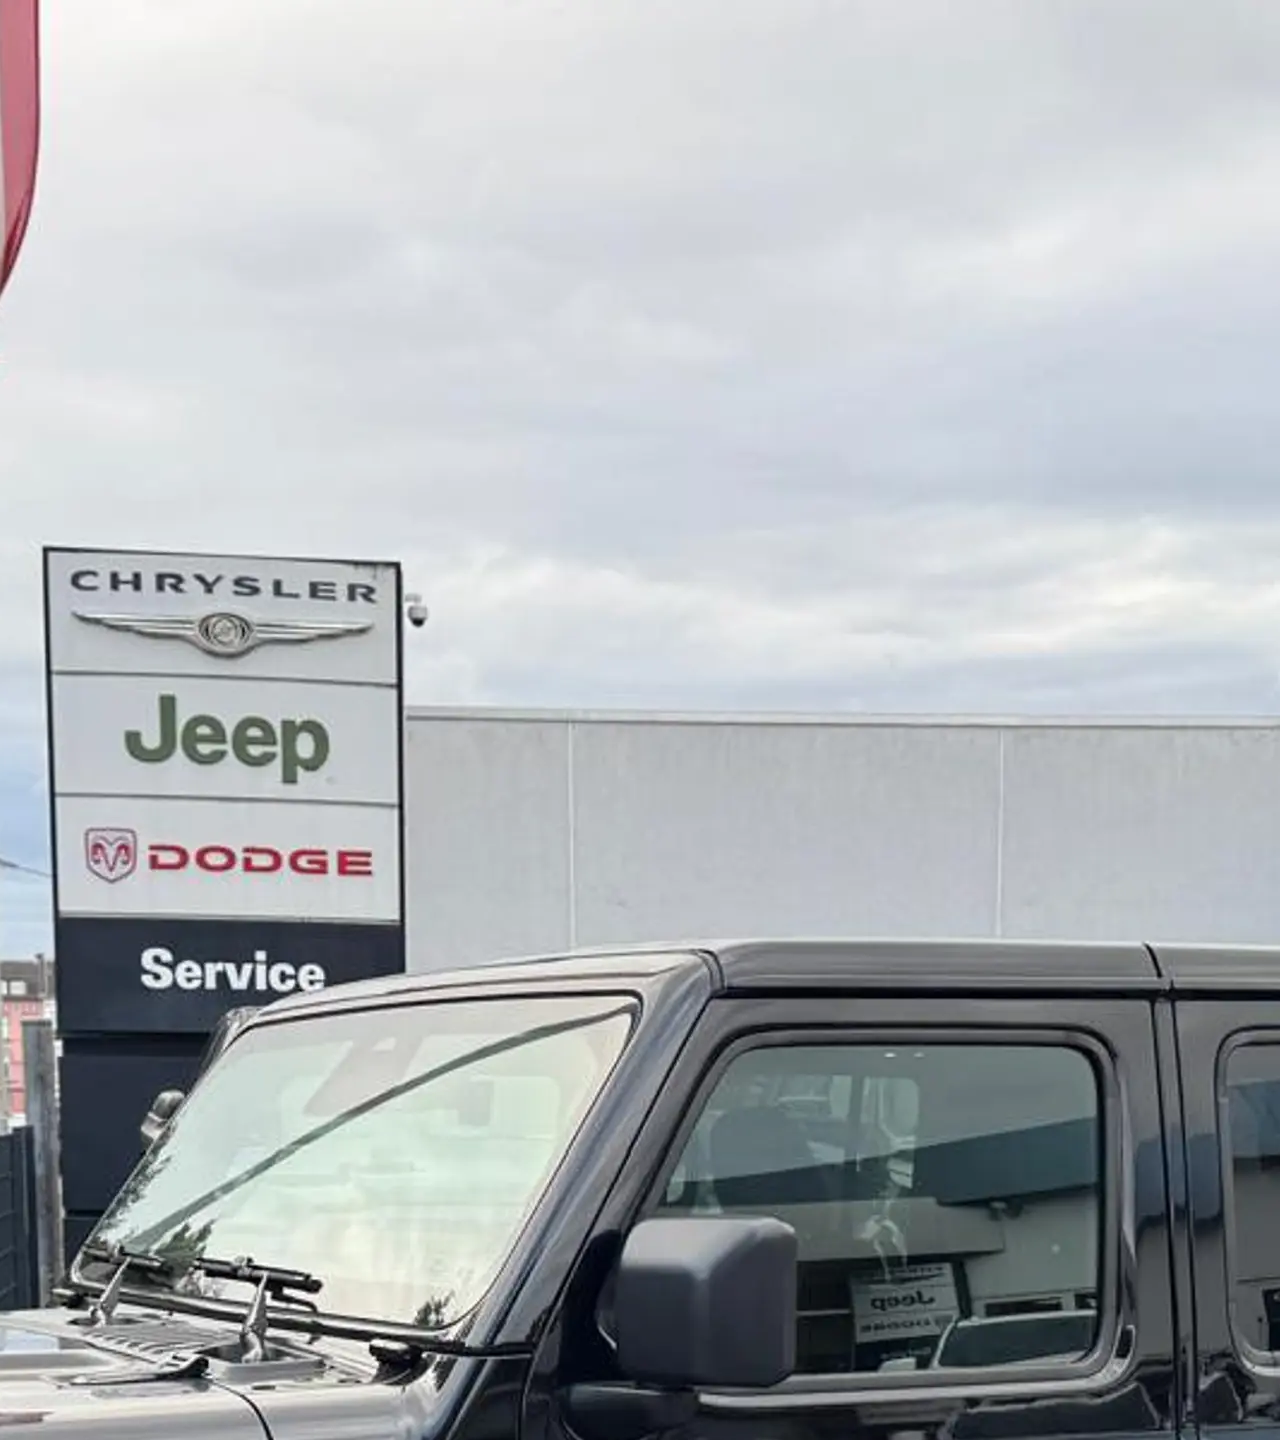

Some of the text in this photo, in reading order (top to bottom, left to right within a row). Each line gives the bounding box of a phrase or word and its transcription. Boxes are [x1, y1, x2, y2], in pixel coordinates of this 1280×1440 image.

[70, 570, 378, 603] CHRYSLER
[124, 694, 330, 785] Jeep
[147, 844, 373, 876] DODGE
[140, 947, 326, 993] Service
